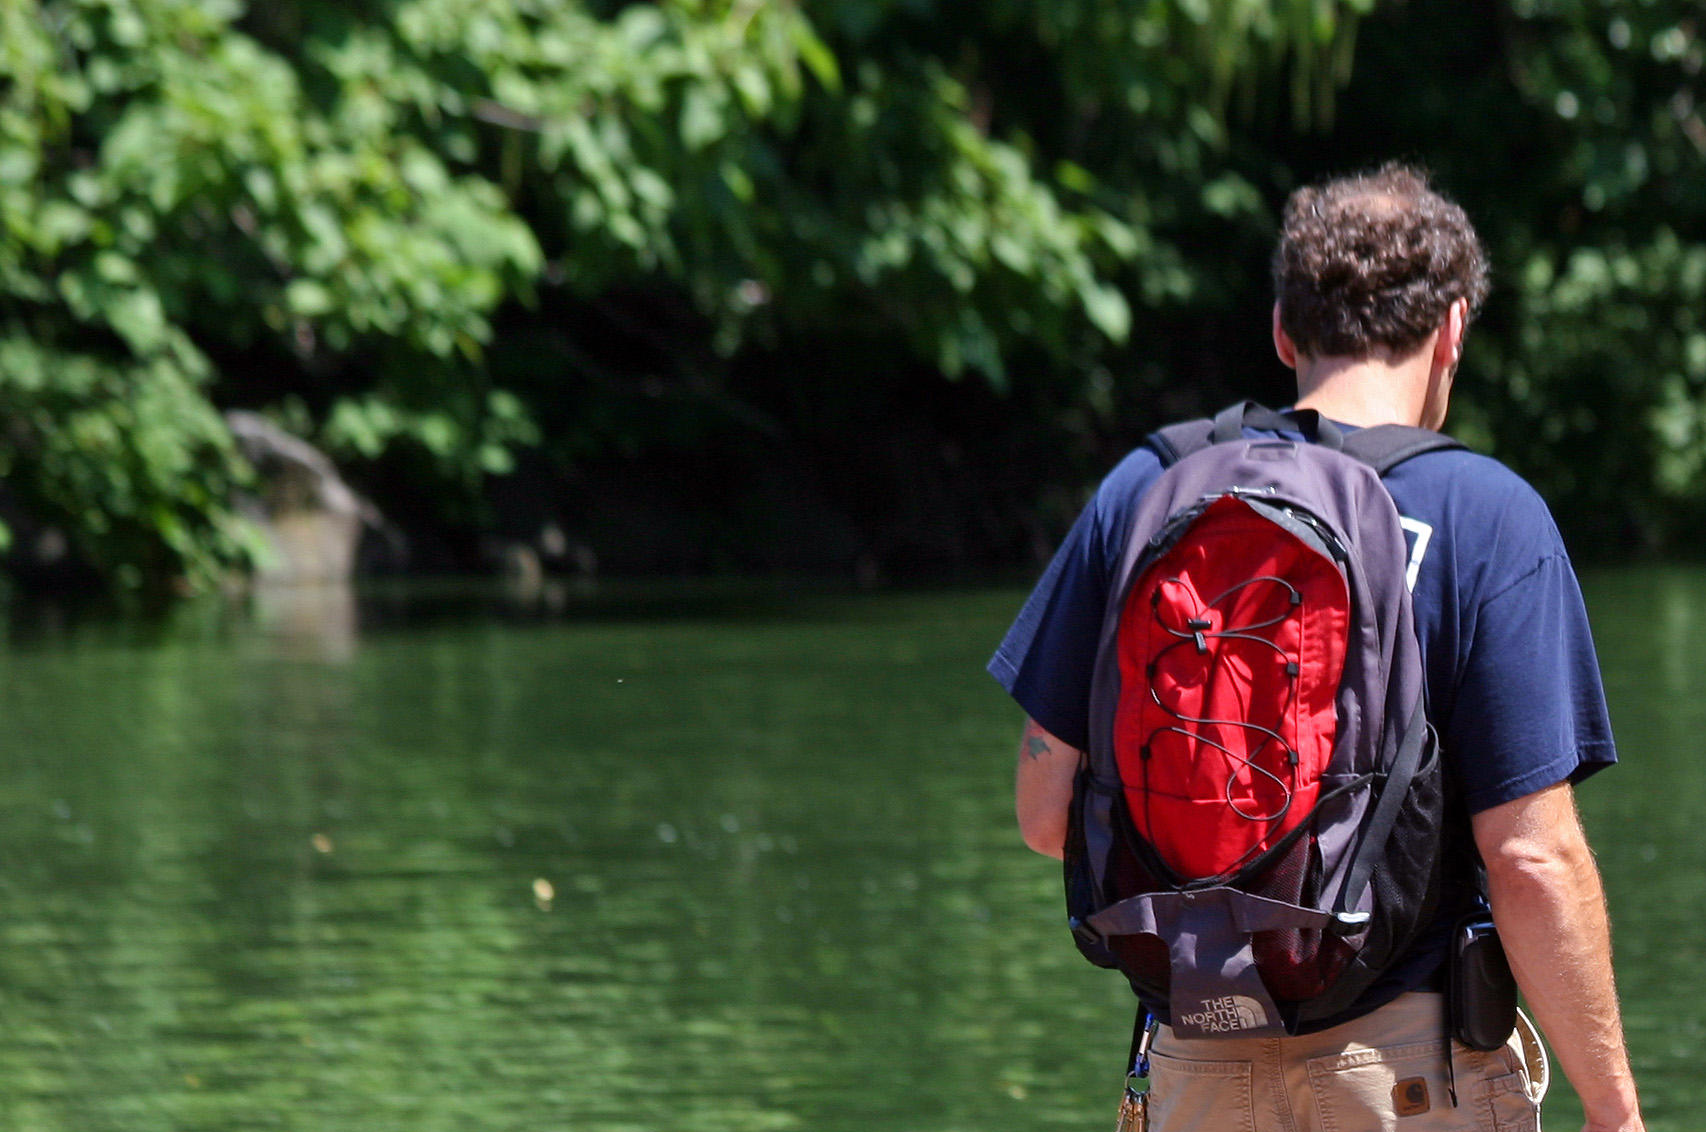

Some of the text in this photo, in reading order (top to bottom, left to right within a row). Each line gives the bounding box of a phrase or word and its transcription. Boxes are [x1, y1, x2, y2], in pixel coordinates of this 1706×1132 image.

[1200, 996, 1234, 1011] THE
[1181, 1007, 1238, 1025] NORTH
[1201, 1018, 1240, 1033] FACE
